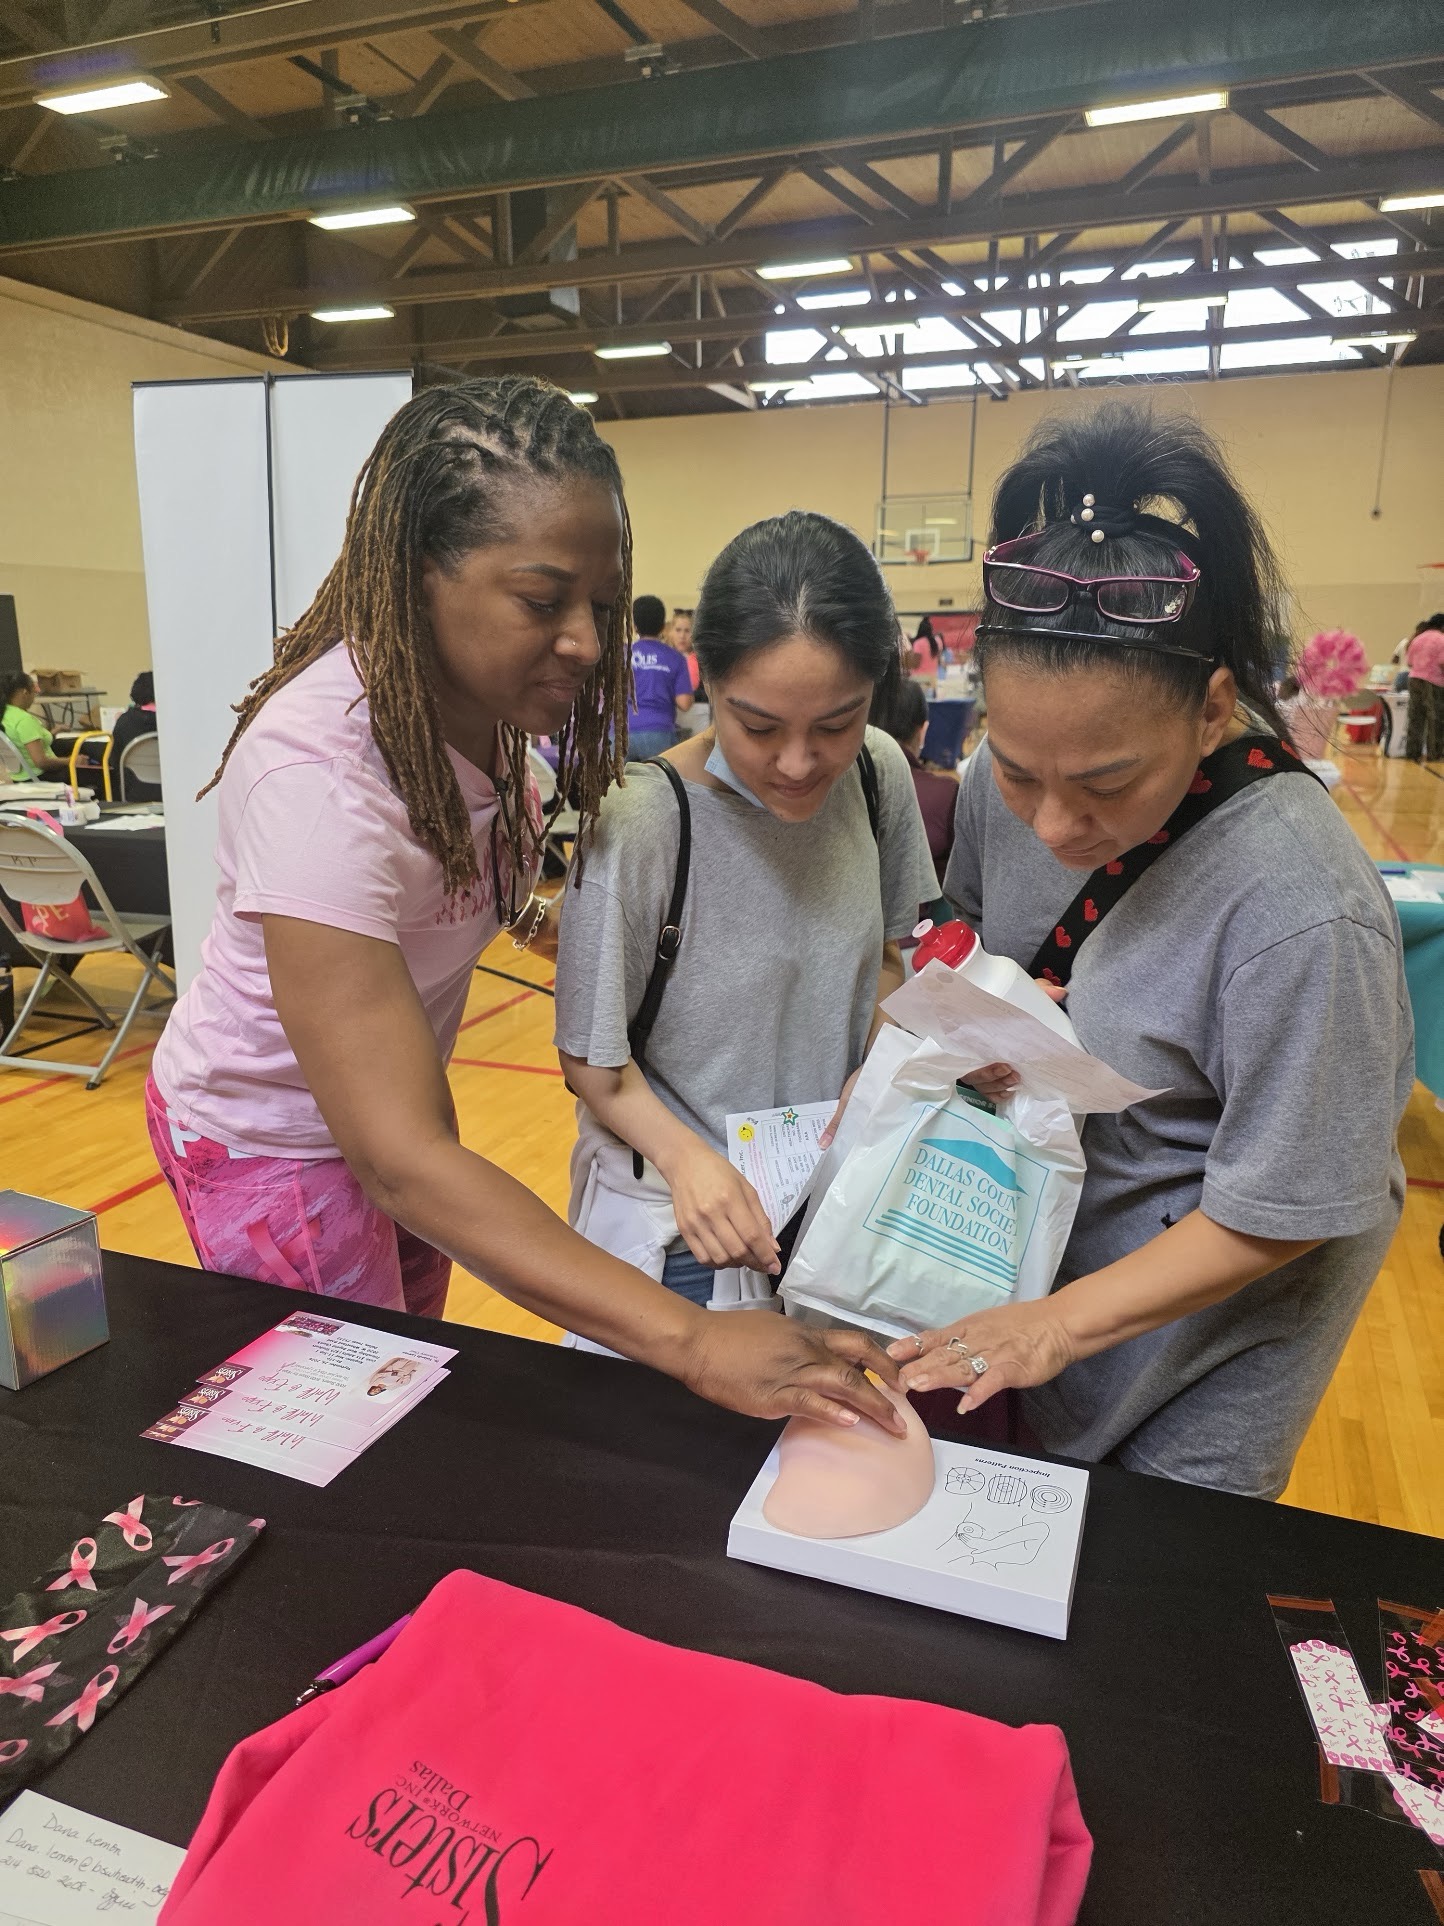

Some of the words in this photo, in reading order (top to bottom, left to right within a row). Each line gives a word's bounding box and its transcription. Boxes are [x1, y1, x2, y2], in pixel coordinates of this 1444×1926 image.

[914, 1147, 975, 1186] DALLAS
[903, 1168, 964, 1208] DENTAL
[906, 1193, 1013, 1256] FOUNDATION
[258, 1372, 289, 1391] Expo
[296, 1387, 341, 1406] Walk
[975, 1458, 1007, 1469] Patterns
[1009, 1466, 1050, 1478] Inspection
[409, 1760, 473, 1813] Dallas
[43, 1812, 79, 1839] Dana
[345, 1788, 554, 1926] Sisters
